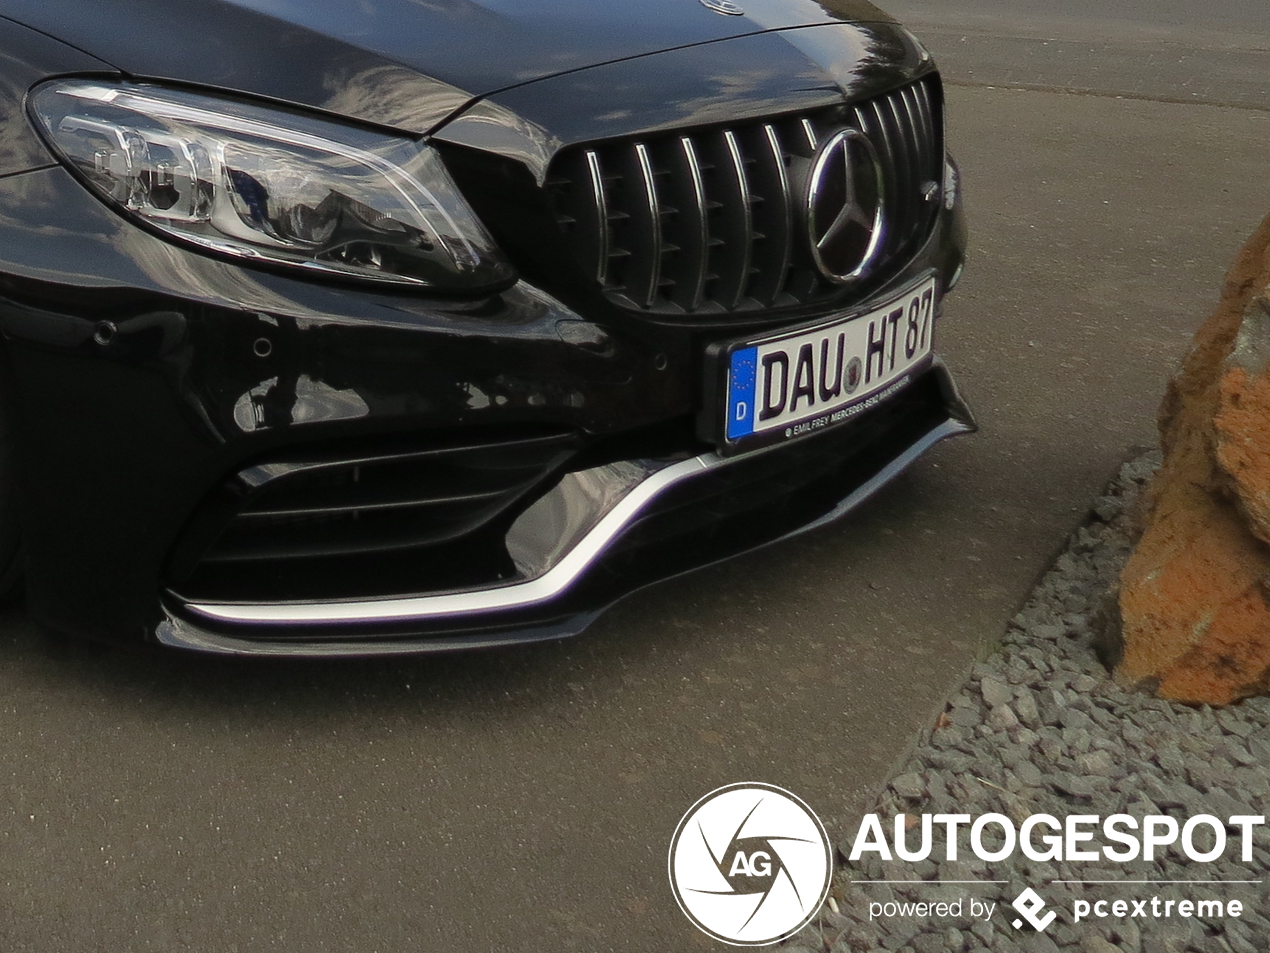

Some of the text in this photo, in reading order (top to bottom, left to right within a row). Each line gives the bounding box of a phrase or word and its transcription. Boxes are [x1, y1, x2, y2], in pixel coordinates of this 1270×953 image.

[759, 287, 933, 422] DAU HT 87
[736, 401, 748, 422] D
